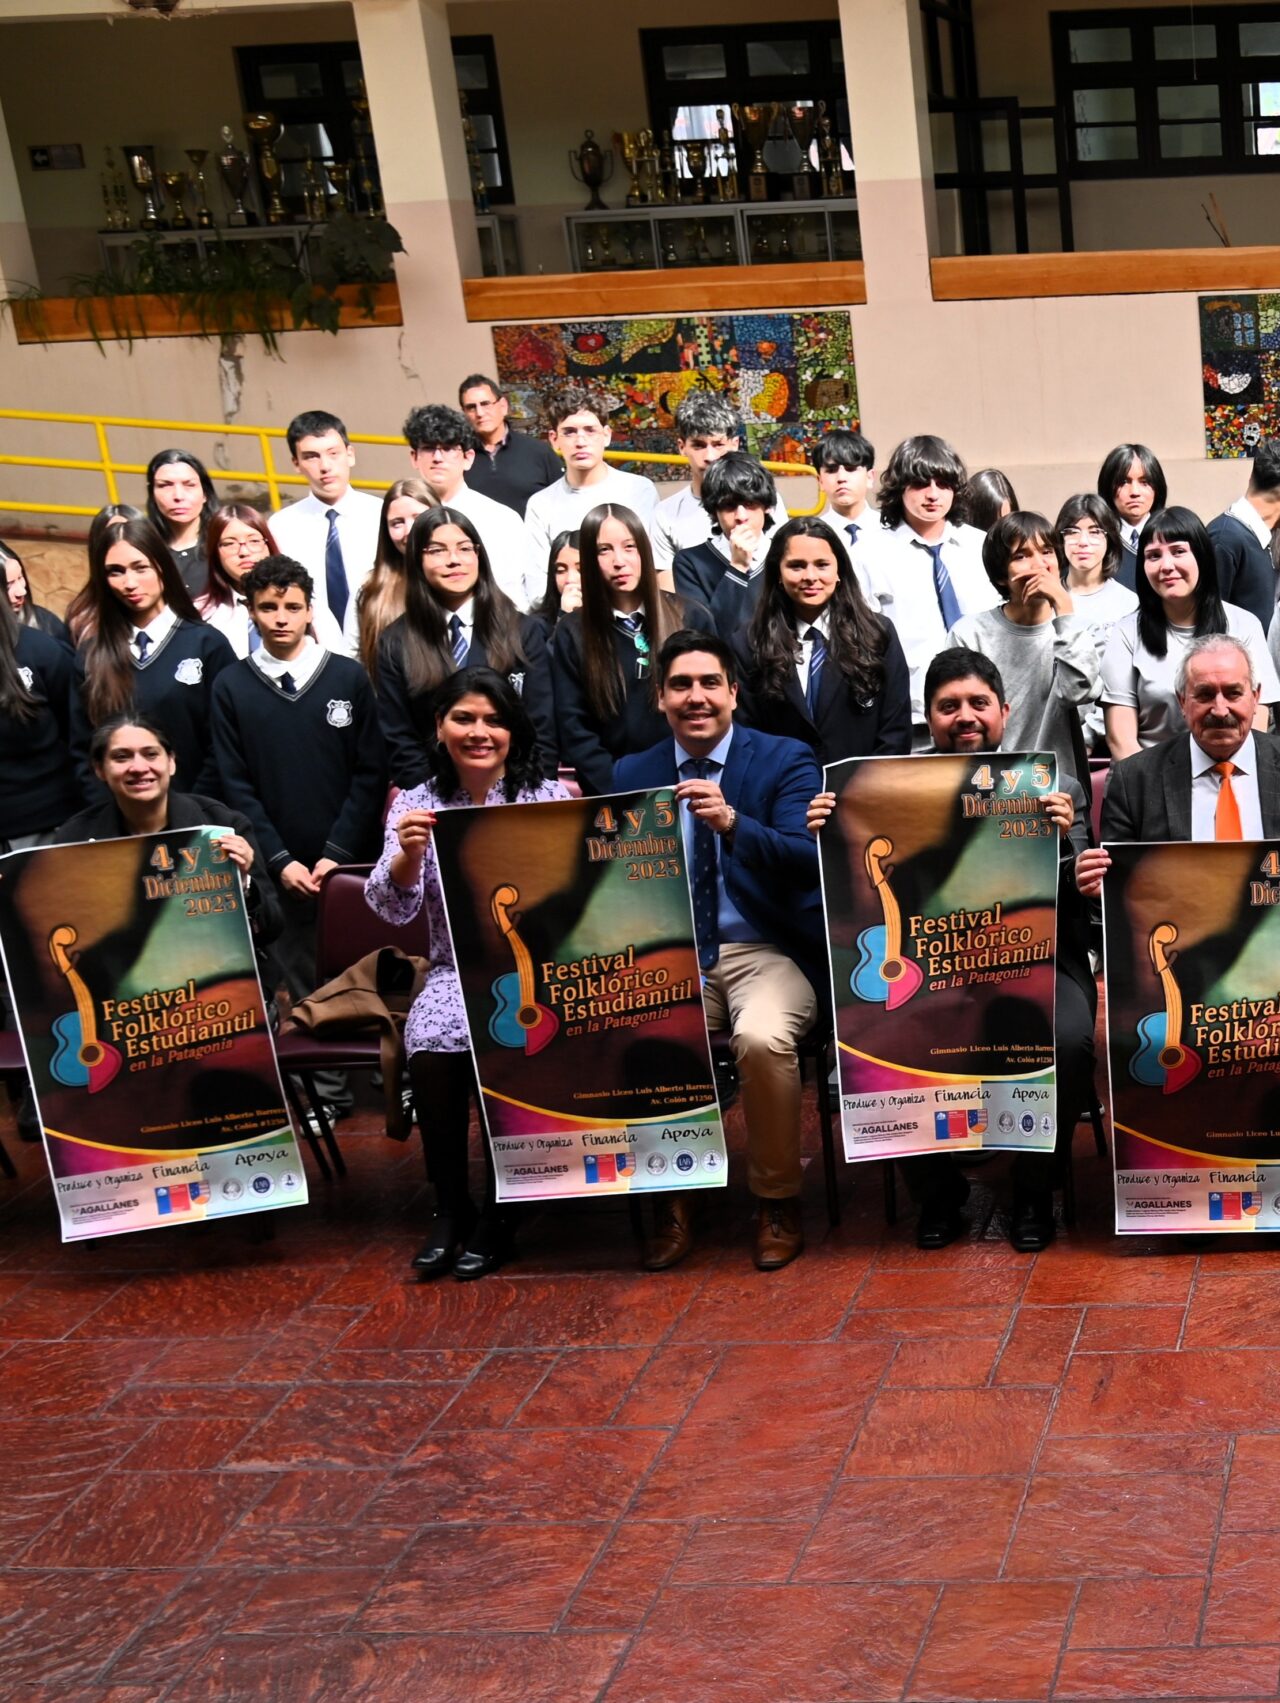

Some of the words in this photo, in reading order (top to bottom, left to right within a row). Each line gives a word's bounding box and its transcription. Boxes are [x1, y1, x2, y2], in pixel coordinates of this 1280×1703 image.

[971, 764, 994, 790] 4
[1000, 769, 1023, 794] y
[1031, 763, 1051, 788] 5
[594, 804, 618, 832] 4
[623, 809, 646, 836] y
[655, 801, 674, 827] 5
[998, 818, 1053, 838] 2025
[150, 844, 174, 870] 4
[178, 846, 200, 873] y
[208, 839, 230, 863] 5
[586, 831, 678, 862] Diciembre
[624, 858, 681, 880] 2025
[142, 867, 234, 899] Diciembre
[184, 892, 238, 917] 2025
[909, 903, 1001, 936] Festival
[916, 926, 1032, 958] Folklórico
[542, 946, 634, 983] Festival
[549, 970, 668, 1004] Folklórico
[929, 979, 946, 991] en
[950, 974, 964, 988] la
[968, 966, 1030, 984] Patagonia
[102, 980, 196, 1020] Festival
[111, 1001, 230, 1041] Folklórico
[566, 1024, 582, 1036] en
[588, 1020, 599, 1032] la
[604, 1006, 670, 1030] Patagonia
[130, 1060, 146, 1072] en
[152, 1056, 164, 1067] la
[168, 1038, 233, 1063] Patagonia
[1208, 1068, 1224, 1078] en
[1230, 1064, 1242, 1076] la
[843, 1098, 877, 1110] Produce
[880, 1099, 886, 1108] y
[888, 1093, 926, 1110] Organiza
[934, 1088, 992, 1102] Financia
[1012, 1088, 1049, 1102] Apoya
[493, 1140, 525, 1152] Produce
[528, 1141, 534, 1150] y
[537, 1136, 573, 1152] Organiza
[582, 1131, 638, 1146] Financia
[662, 1128, 712, 1142] Apoya
[152, 1160, 210, 1179] Financia
[235, 1150, 288, 1166] Apoya
[57, 1180, 92, 1193] Produce
[96, 1180, 102, 1190] y
[104, 1171, 143, 1190] Organiza
[1118, 1174, 1150, 1184] Produce
[1154, 1176, 1159, 1185] y
[1162, 1173, 1200, 1188] Organiza
[1210, 1170, 1266, 1183] Financia
